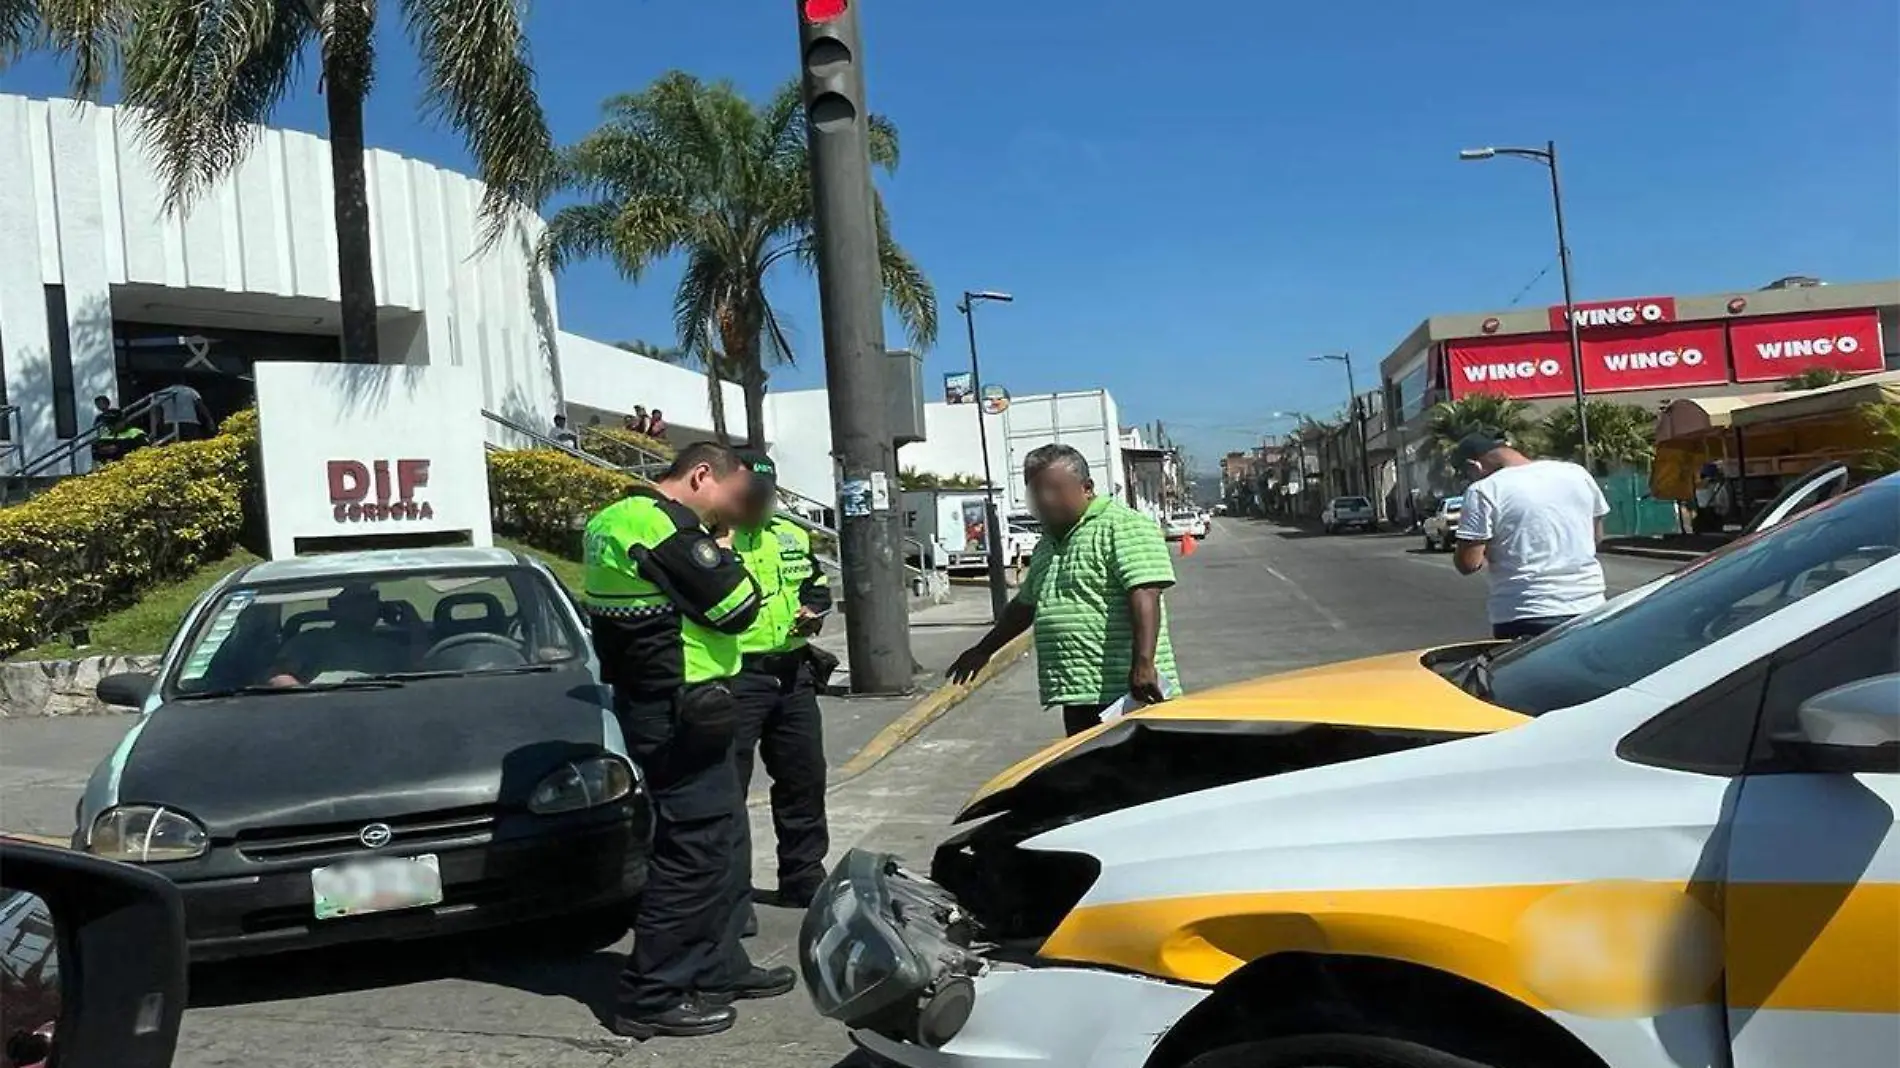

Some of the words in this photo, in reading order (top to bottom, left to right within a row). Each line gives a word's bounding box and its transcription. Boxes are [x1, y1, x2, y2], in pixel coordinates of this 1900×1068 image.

[1565, 303, 1661, 326] WING'O
[1603, 347, 1702, 371] WING'O
[1756, 336, 1858, 359] WING'O
[1463, 359, 1560, 382] WING'O
[327, 460, 430, 504] DIF
